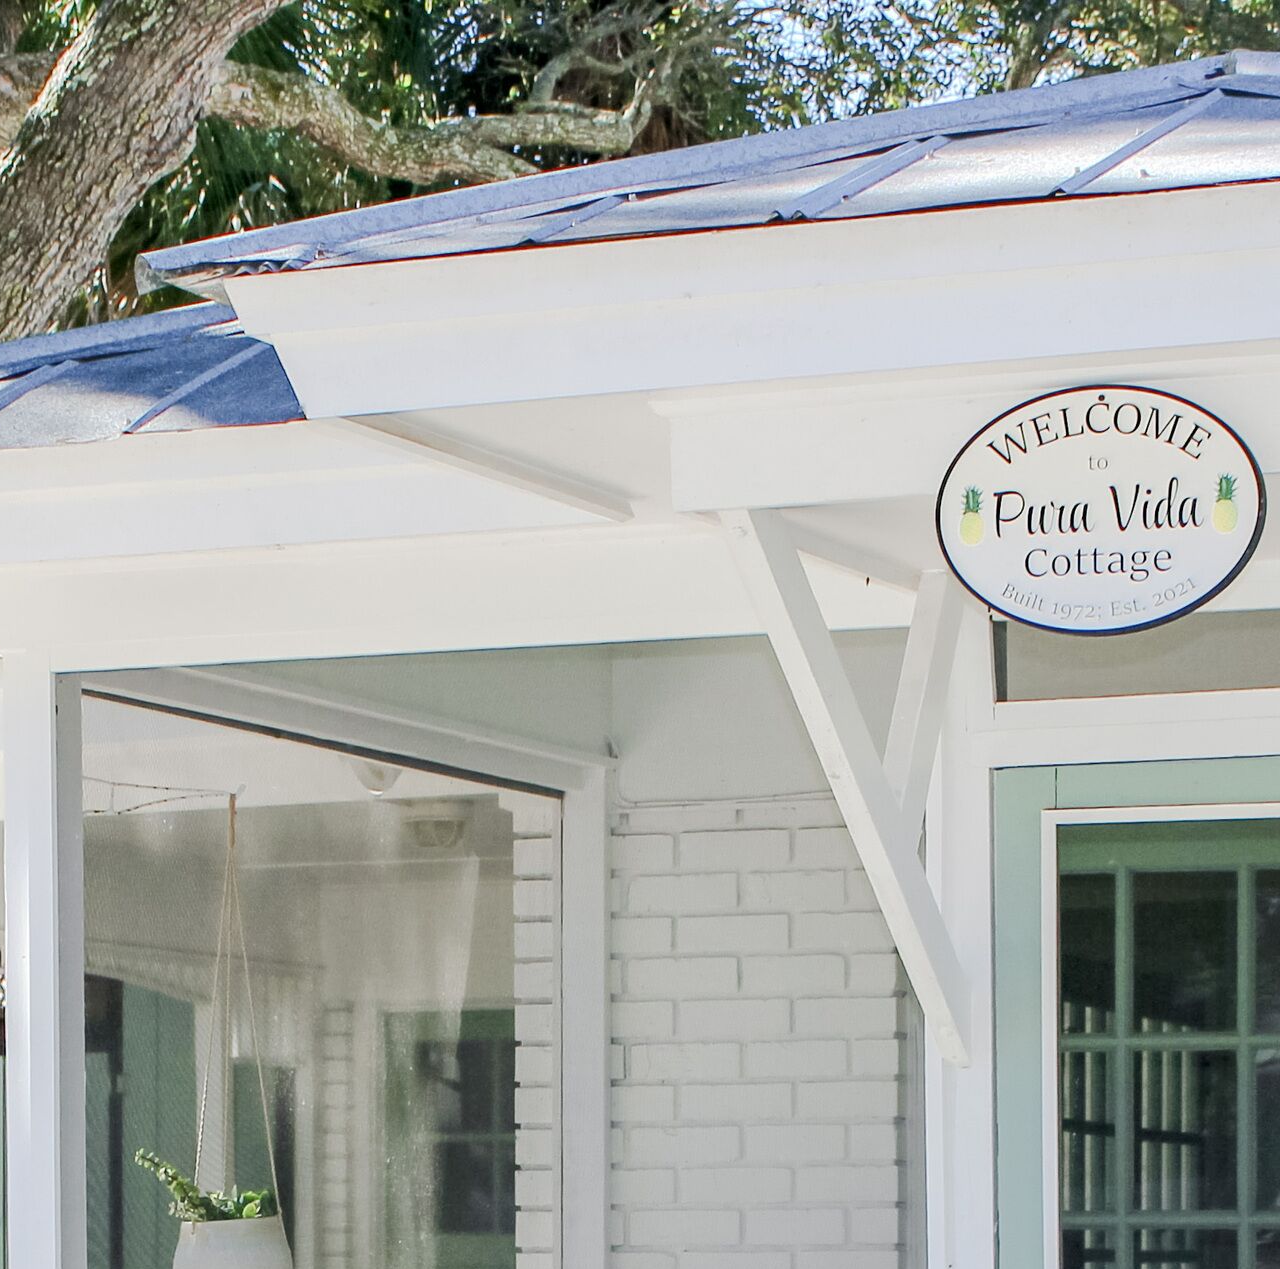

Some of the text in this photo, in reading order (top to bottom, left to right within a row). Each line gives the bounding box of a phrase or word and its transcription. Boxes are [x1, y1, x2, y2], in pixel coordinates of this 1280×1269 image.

[986, 401, 1212, 466] WELCOME
[1088, 454, 1109, 471] to
[993, 477, 1205, 538] Pura Vida
[1024, 547, 1173, 582] Cottage
[1000, 583, 1044, 611] Built
[1111, 600, 1147, 617] Est.
[1153, 578, 1197, 608] 2021
